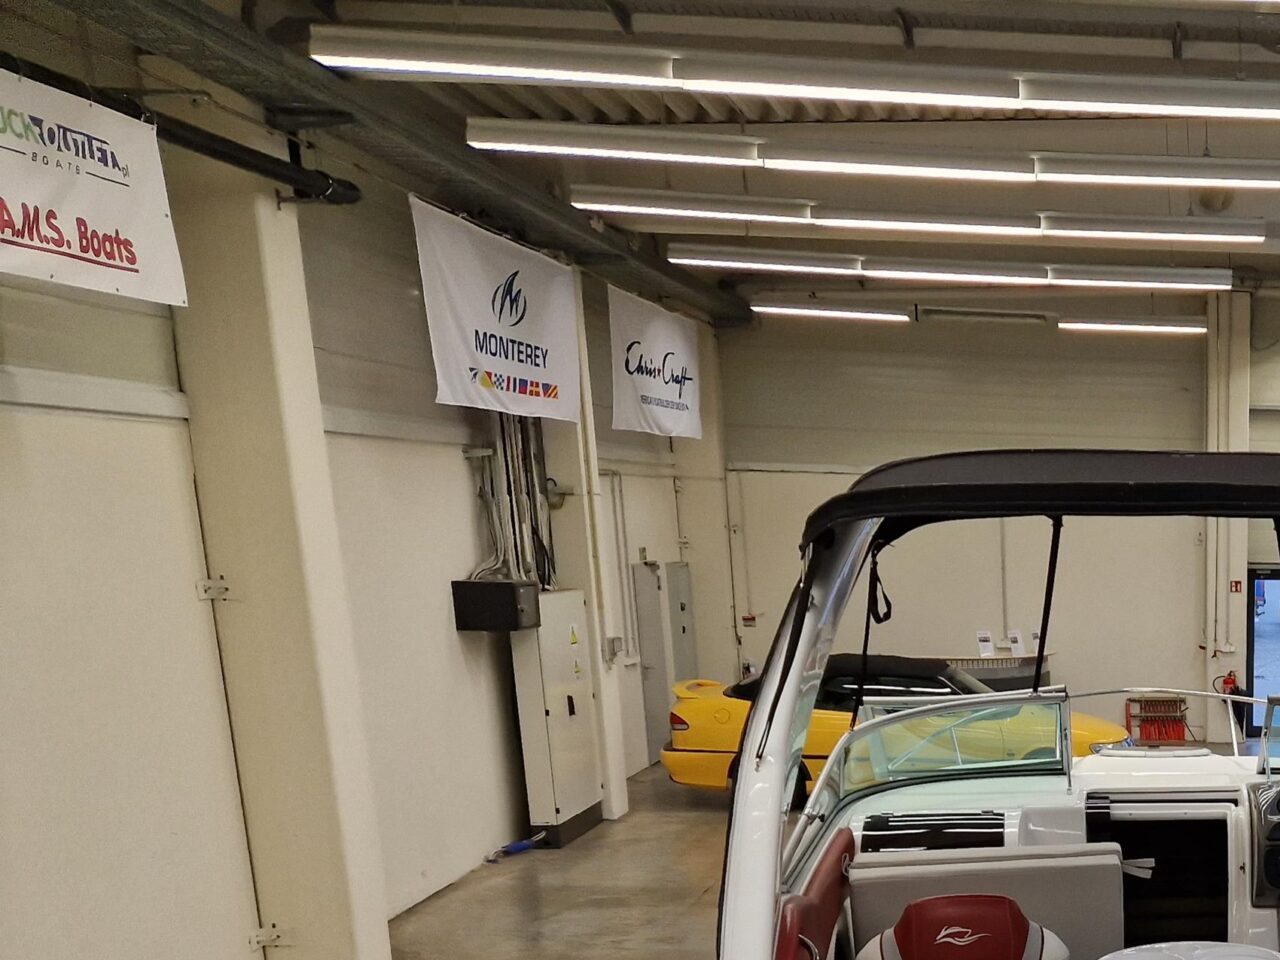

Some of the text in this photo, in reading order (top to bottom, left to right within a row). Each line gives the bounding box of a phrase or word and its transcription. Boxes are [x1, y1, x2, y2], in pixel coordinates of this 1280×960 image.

[31, 152, 81, 175] BOATS
[76, 217, 138, 265] Boats
[474, 329, 549, 369] MONTEREY
